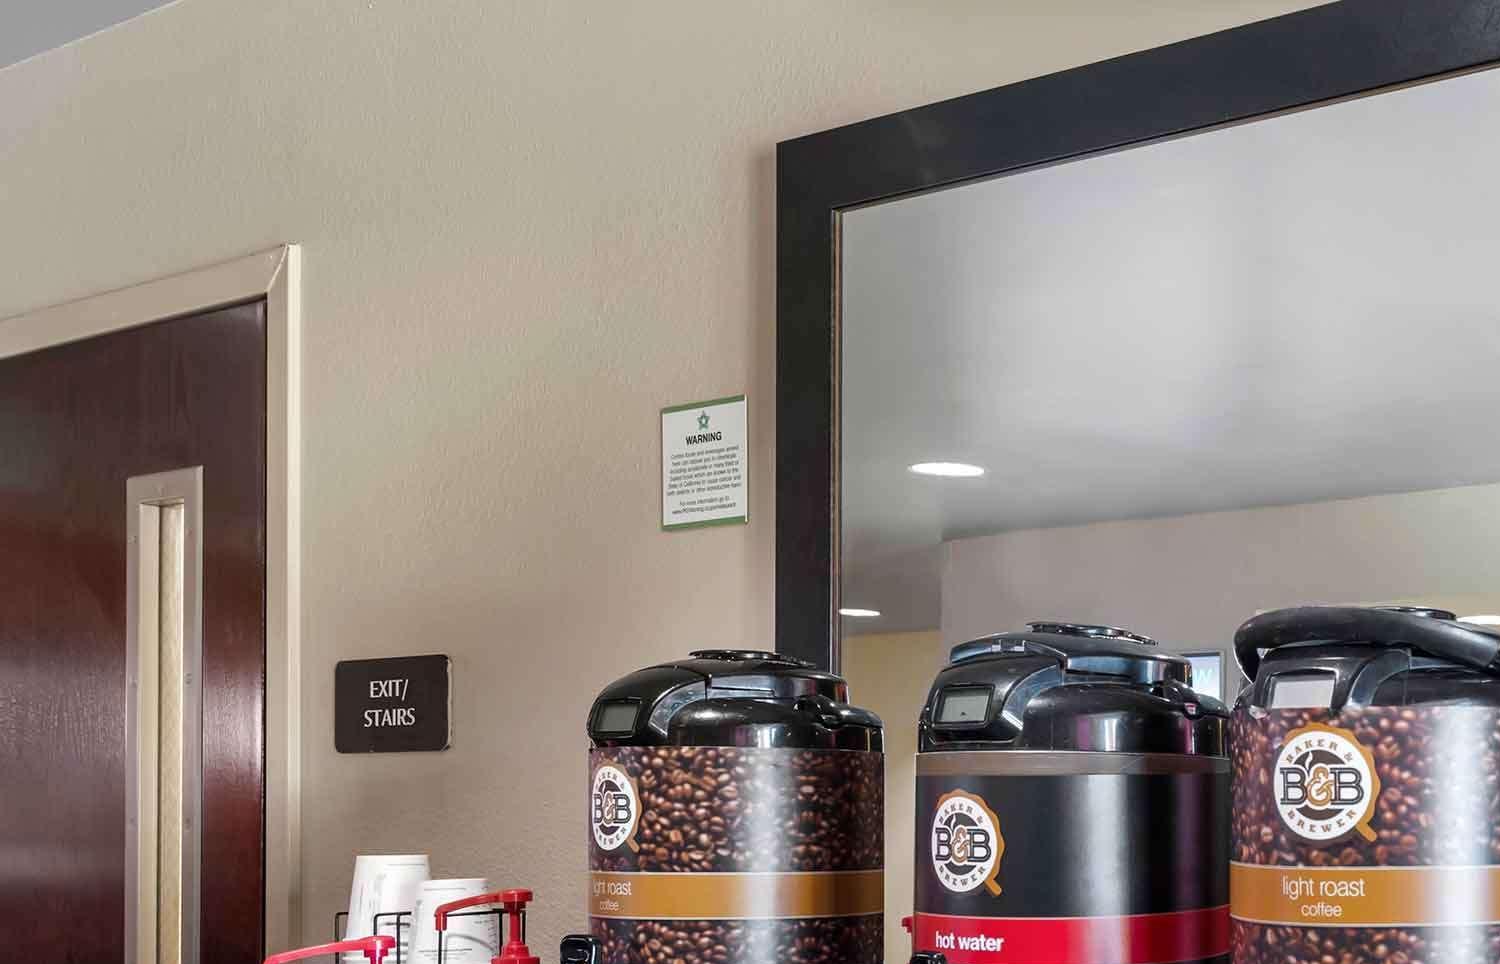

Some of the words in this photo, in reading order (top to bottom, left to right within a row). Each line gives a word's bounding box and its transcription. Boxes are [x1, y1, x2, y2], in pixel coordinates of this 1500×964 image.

[686, 432, 722, 445] WARNING
[370, 679, 408, 701] EXIT/
[364, 708, 416, 727] STAIRS
[607, 880, 632, 896] roast
[1281, 876, 1314, 900] light
[1319, 878, 1365, 896] roast
[1301, 903, 1342, 917] coffee
[935, 931, 956, 949] hot
[957, 935, 1004, 952] water
